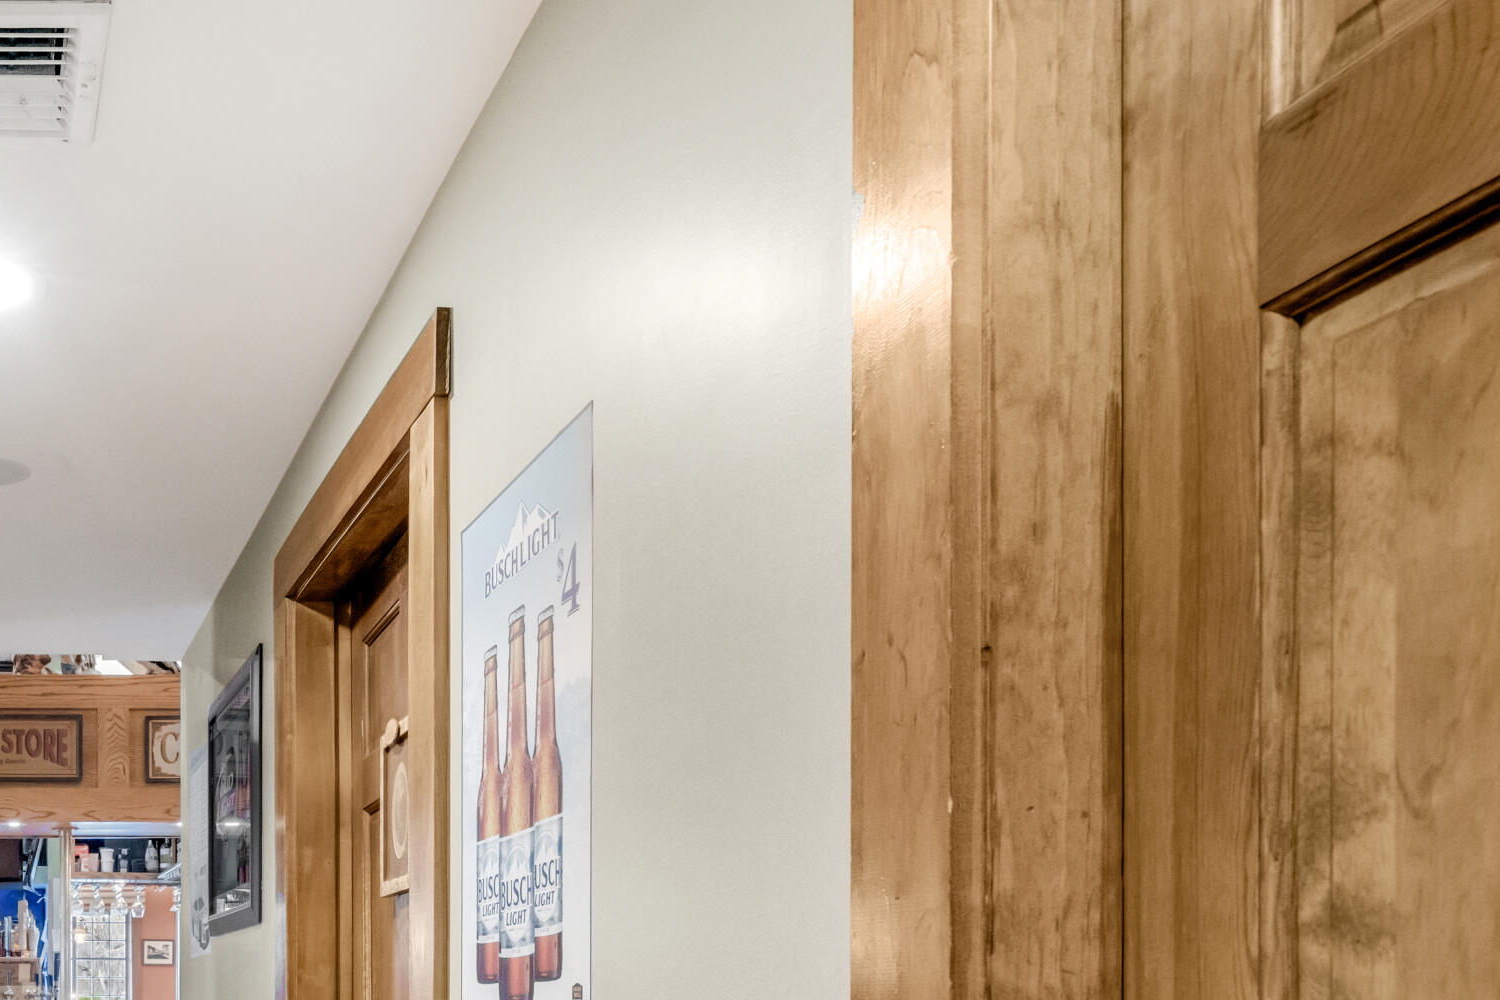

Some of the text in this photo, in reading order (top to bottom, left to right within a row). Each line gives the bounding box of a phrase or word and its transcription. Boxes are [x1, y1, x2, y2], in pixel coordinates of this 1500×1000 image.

[1, 727, 69, 768] STORE
[160, 731, 180, 765] C
[478, 873, 499, 904] BUSC
[534, 858, 561, 890] USCH
[500, 874, 533, 911] BUSCH
[534, 890, 555, 907] LIGHT
[506, 908, 527, 927] LIGHT
